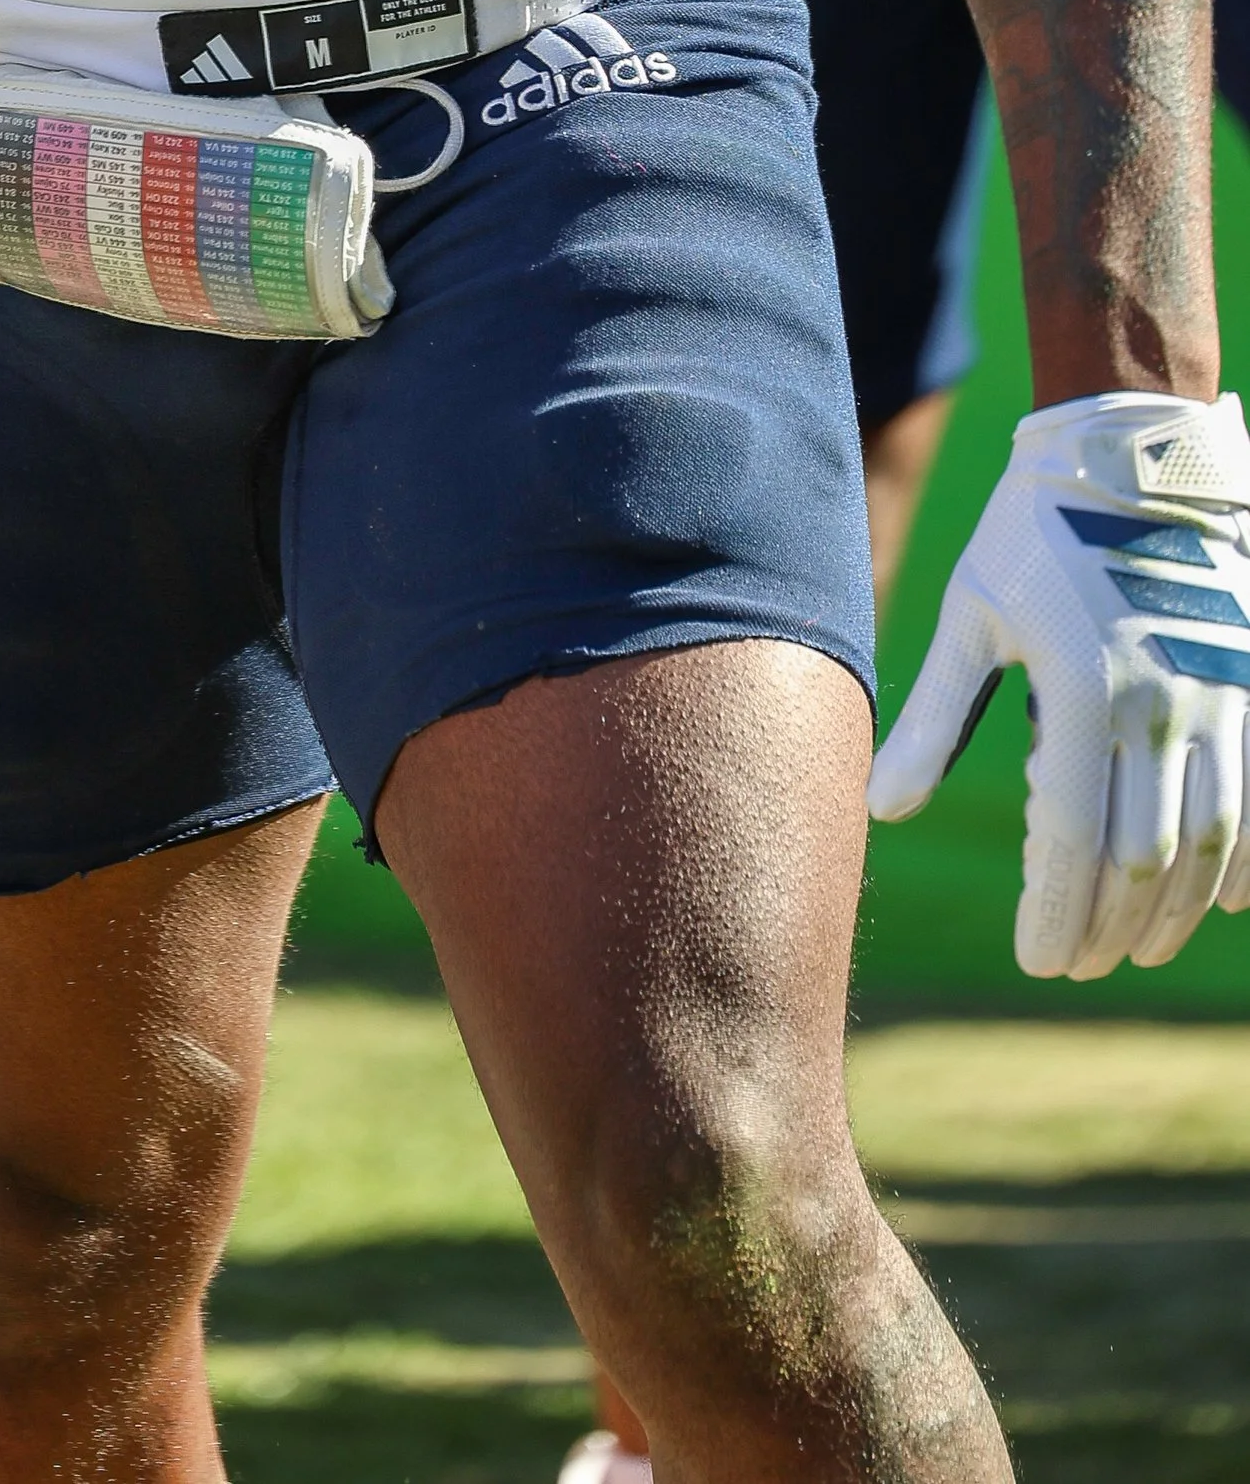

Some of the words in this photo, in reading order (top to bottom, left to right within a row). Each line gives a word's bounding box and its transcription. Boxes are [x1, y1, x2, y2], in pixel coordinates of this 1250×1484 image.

[382, 0, 401, 11] ONLY
[380, 12, 396, 23] FOR
[398, 10, 412, 20] THE
[414, 3, 447, 16] ATHLETE
[303, 14, 322, 24] SIZE
[395, 26, 426, 40] PLAYER
[427, 25, 437, 33] ID
[305, 37, 333, 70] M
[482, 49, 677, 127] adidas
[26, 119, 36, 128] S3
[22, 135, 34, 143] S2
[165, 138, 183, 147] 242
[111, 146, 127, 155] 242
[205, 142, 219, 151] VA
[164, 169, 181, 177] 243
[0, 174, 17, 183] 233
[147, 180, 179, 191] Bronco
[96, 186, 125, 197] Husky
[259, 193, 271, 202] TX
[274, 196, 291, 204] 242
[5, 212, 17, 221] 75
[108, 214, 125, 223] Sox
[217, 215, 234, 224] 243
[163, 221, 179, 229] 245
[1036, 834, 1076, 950] ADIZERO
